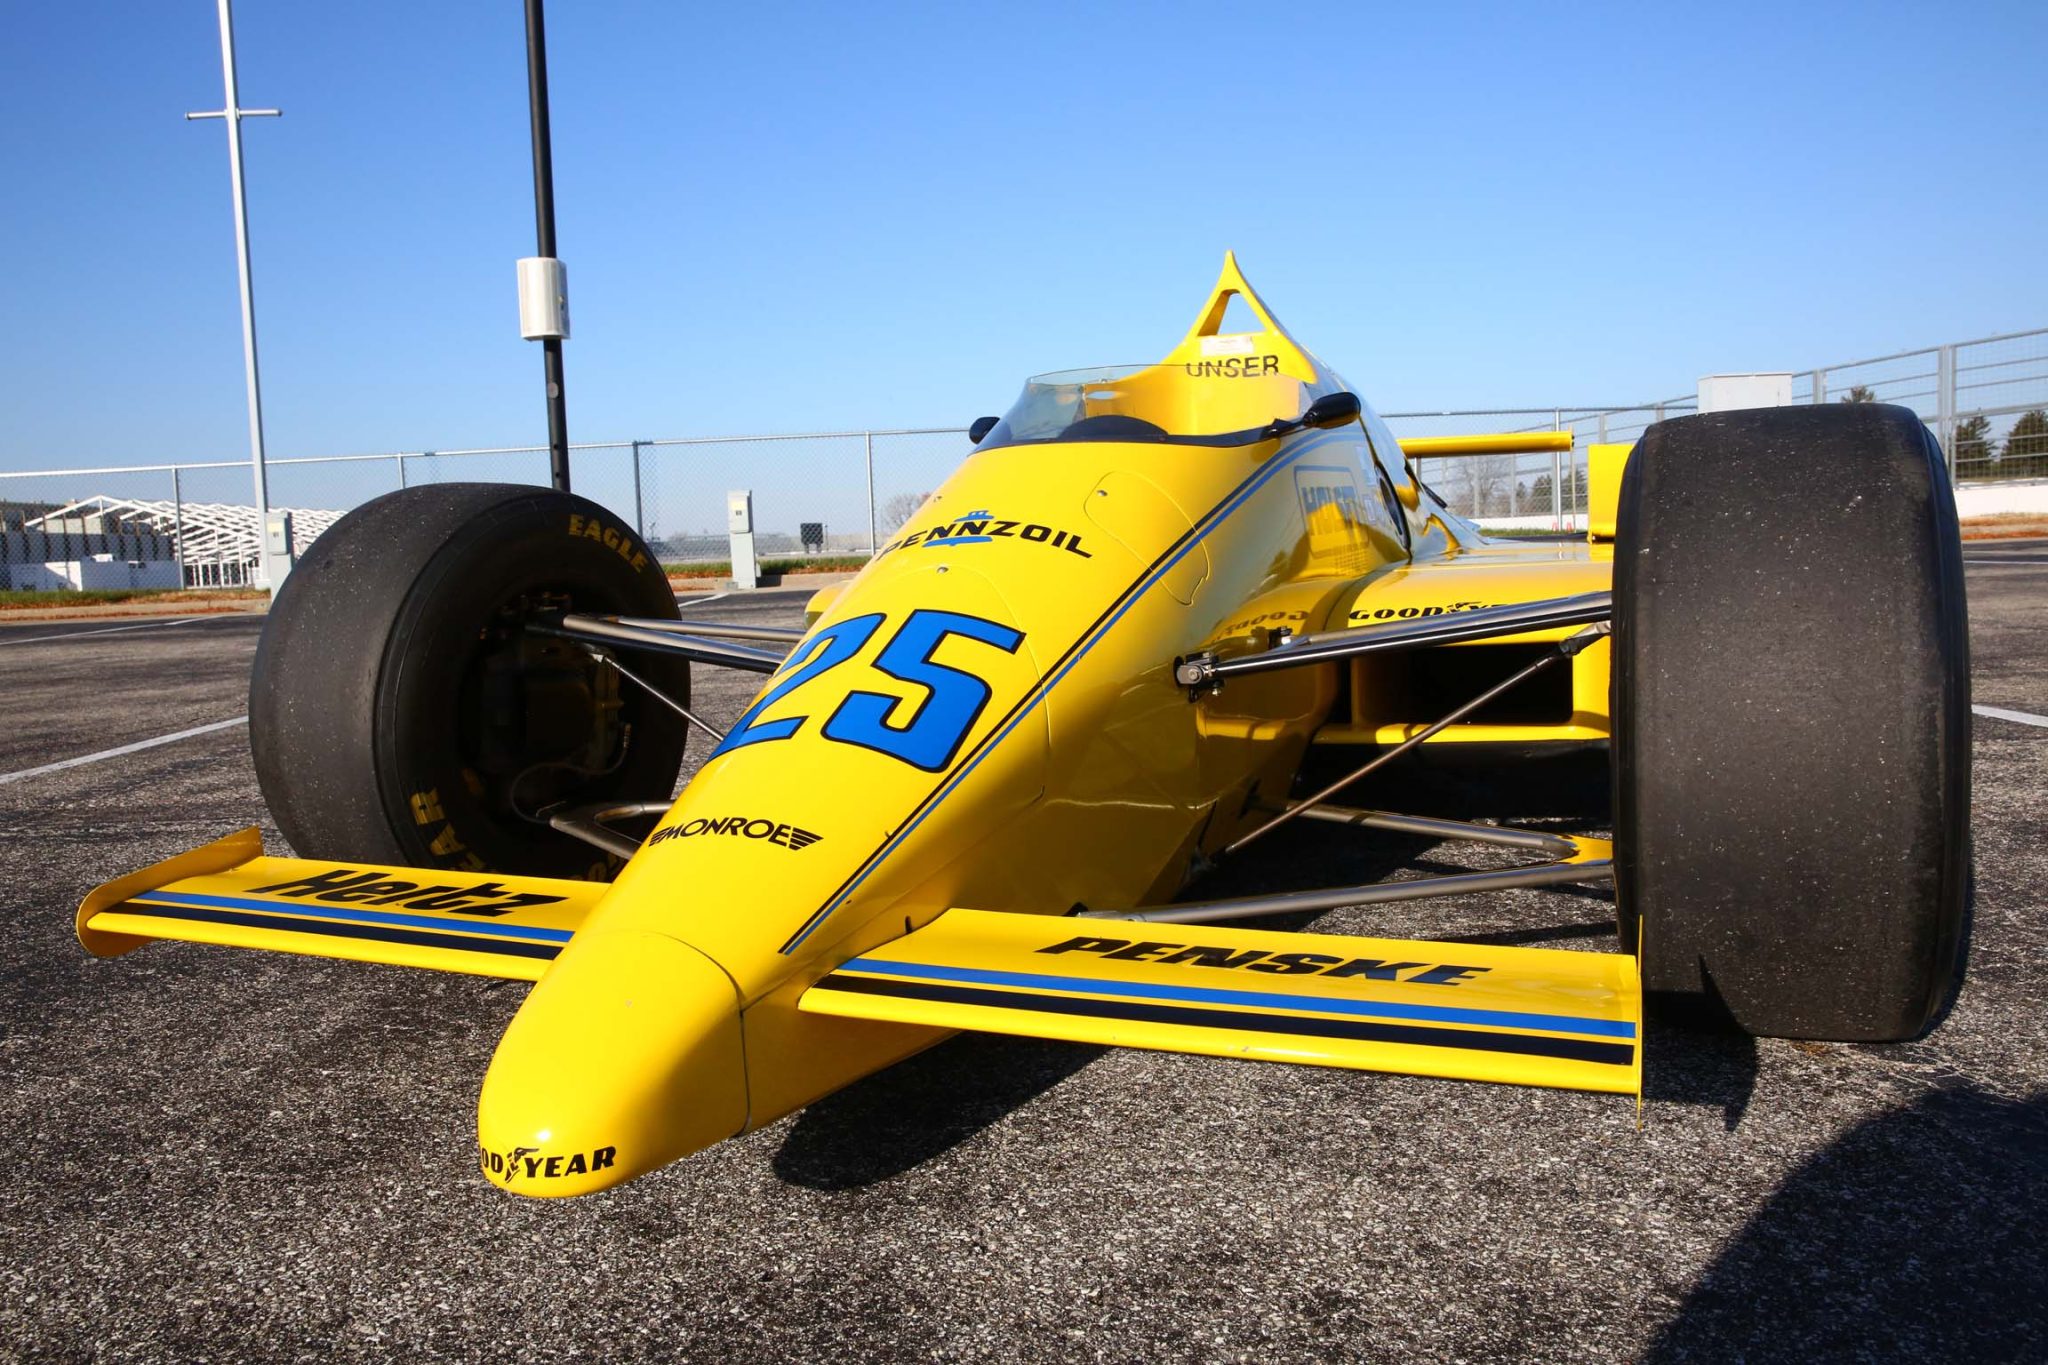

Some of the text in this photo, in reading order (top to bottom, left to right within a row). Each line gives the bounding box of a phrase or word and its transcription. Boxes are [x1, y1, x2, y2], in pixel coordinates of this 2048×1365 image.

[1186, 355, 1279, 378] UNSER
[569, 514, 649, 574] EAGLE
[876, 521, 1092, 562] PENNZOIL
[706, 609, 1027, 774] 25
[664, 817, 791, 847] MONROE
[244, 869, 569, 917] Hertz
[1035, 936, 1493, 986] PENSKE
[481, 1146, 617, 1178] ODYEAR
